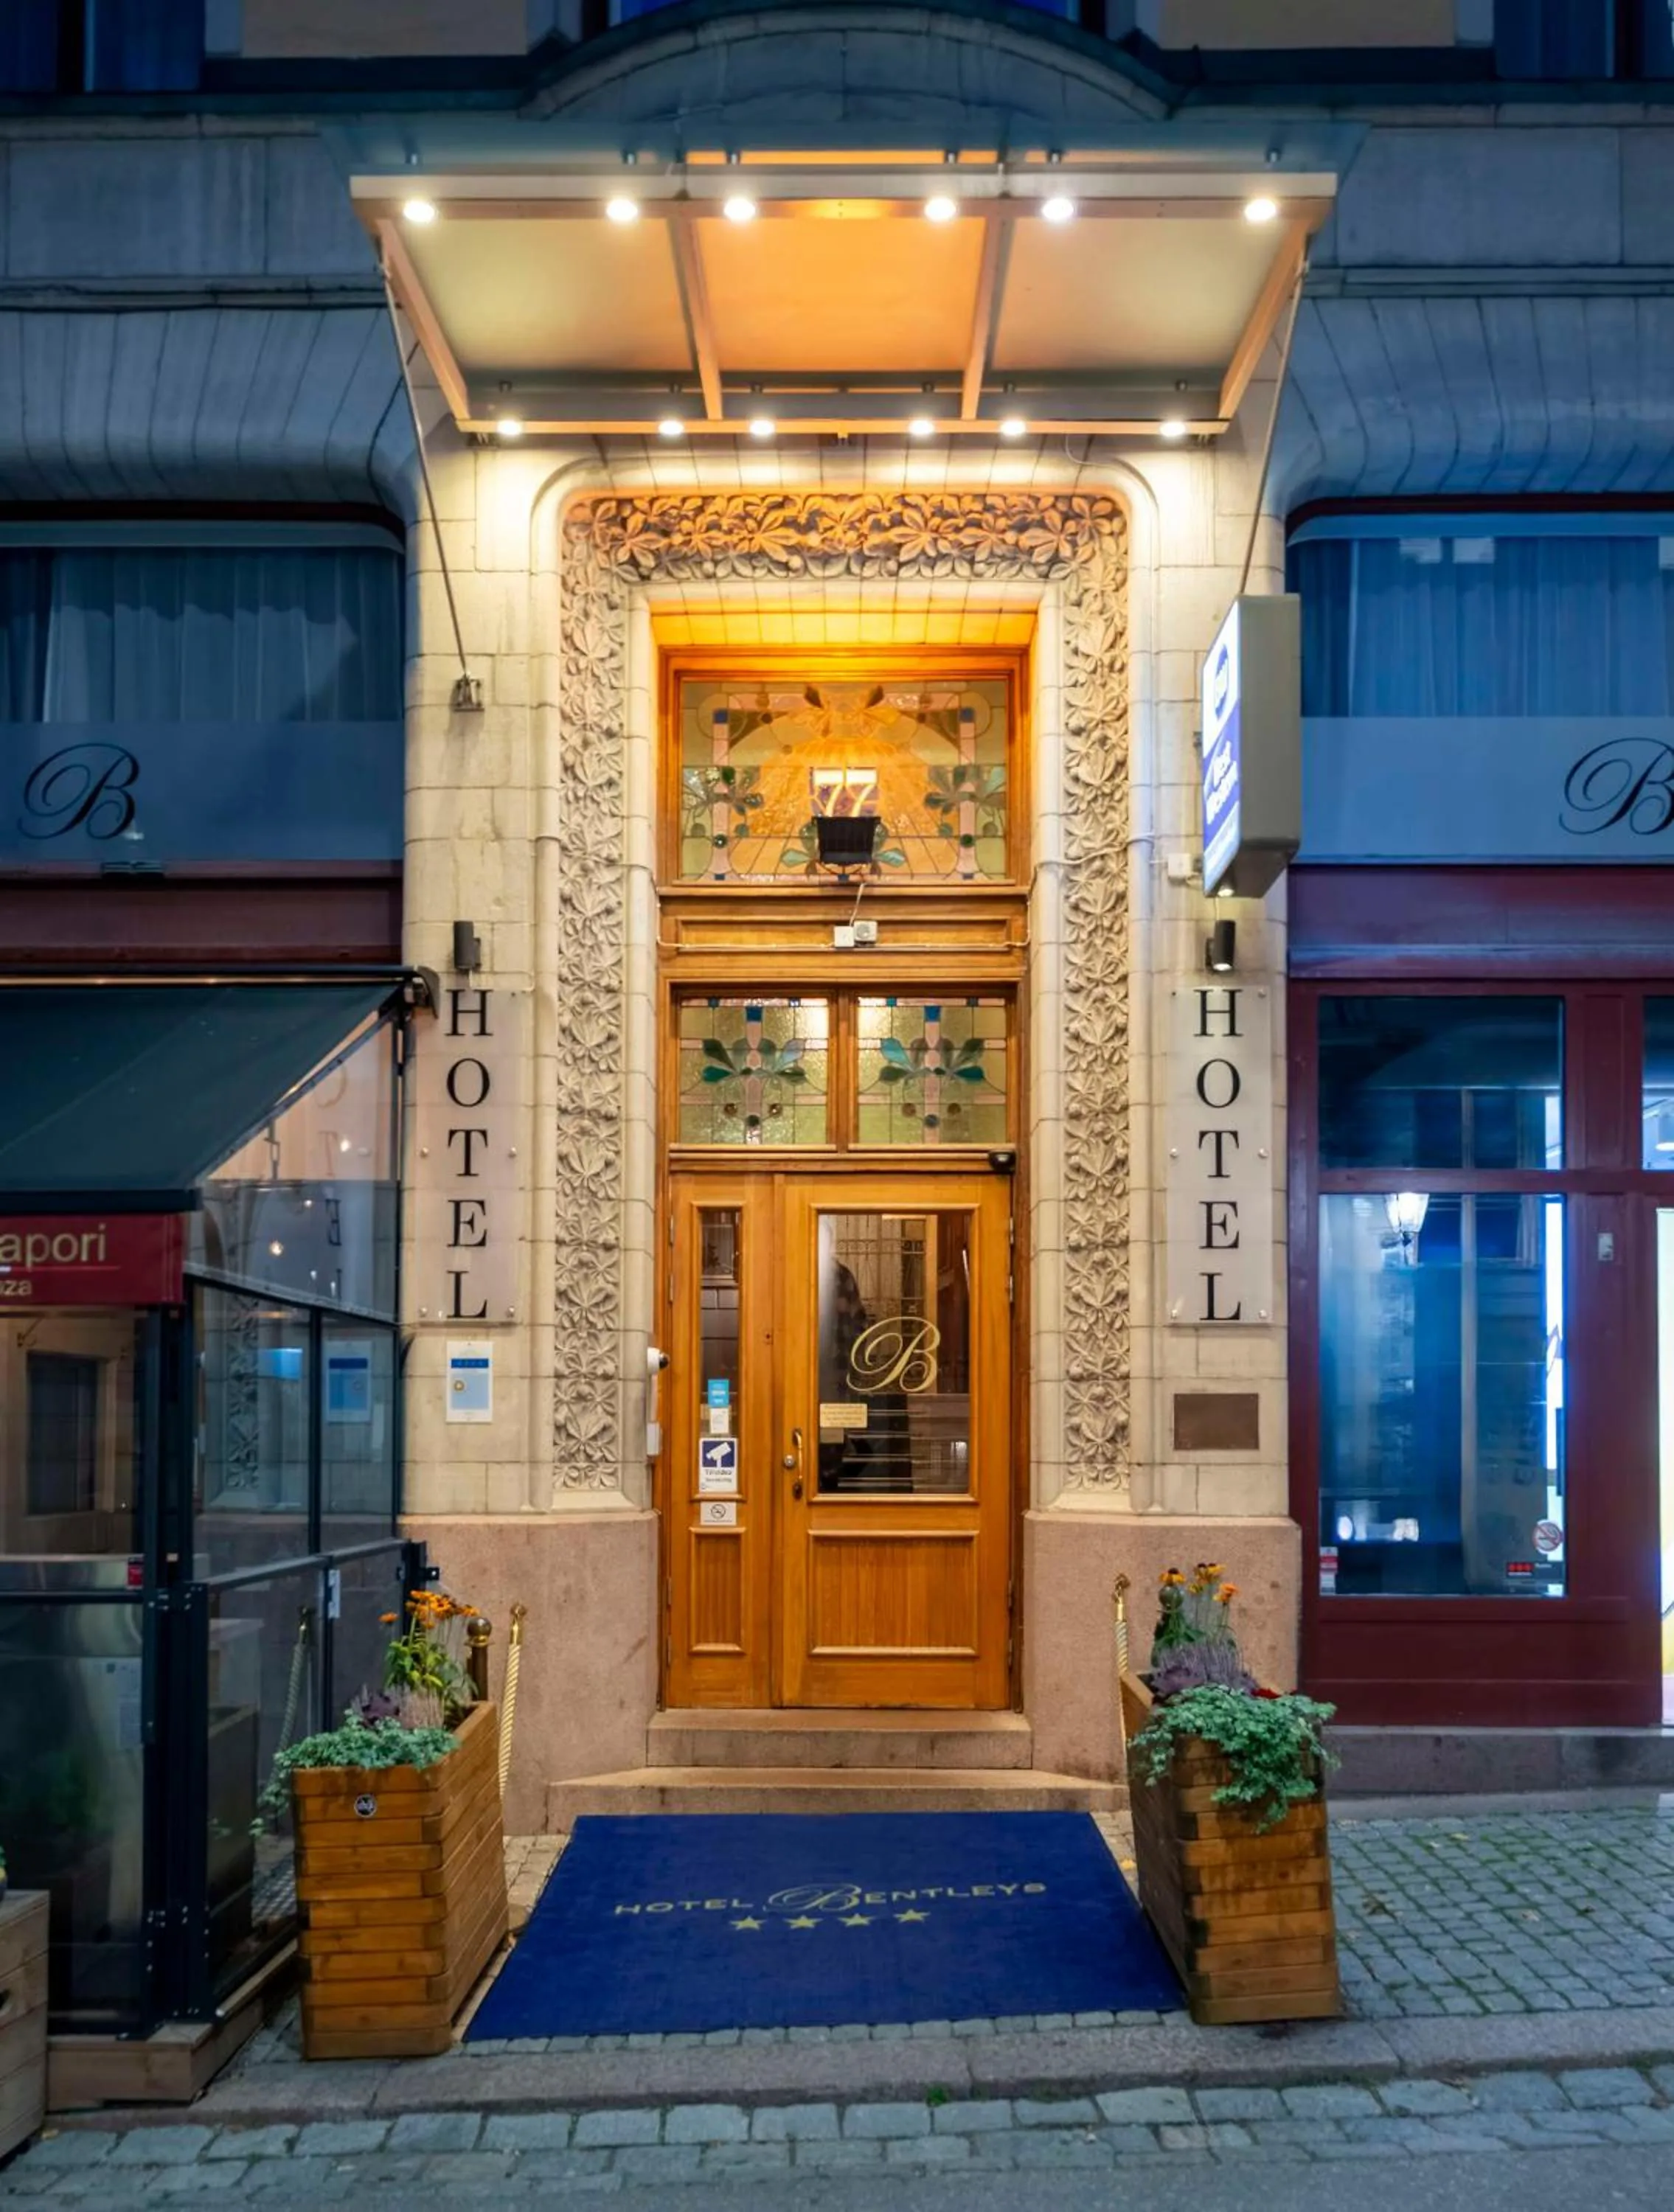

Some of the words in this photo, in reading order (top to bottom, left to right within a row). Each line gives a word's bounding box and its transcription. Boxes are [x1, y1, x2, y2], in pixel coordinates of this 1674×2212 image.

[18, 743, 140, 841] B
[813, 769, 877, 818] 77
[1559, 737, 1674, 835] B
[445, 988, 493, 1319] HOTEL
[1195, 989, 1243, 1321] HOTEL
[846, 1316, 941, 1392] B
[614, 1899, 754, 1915] HOTEL
[763, 1883, 1046, 1912] BENTLEYS
